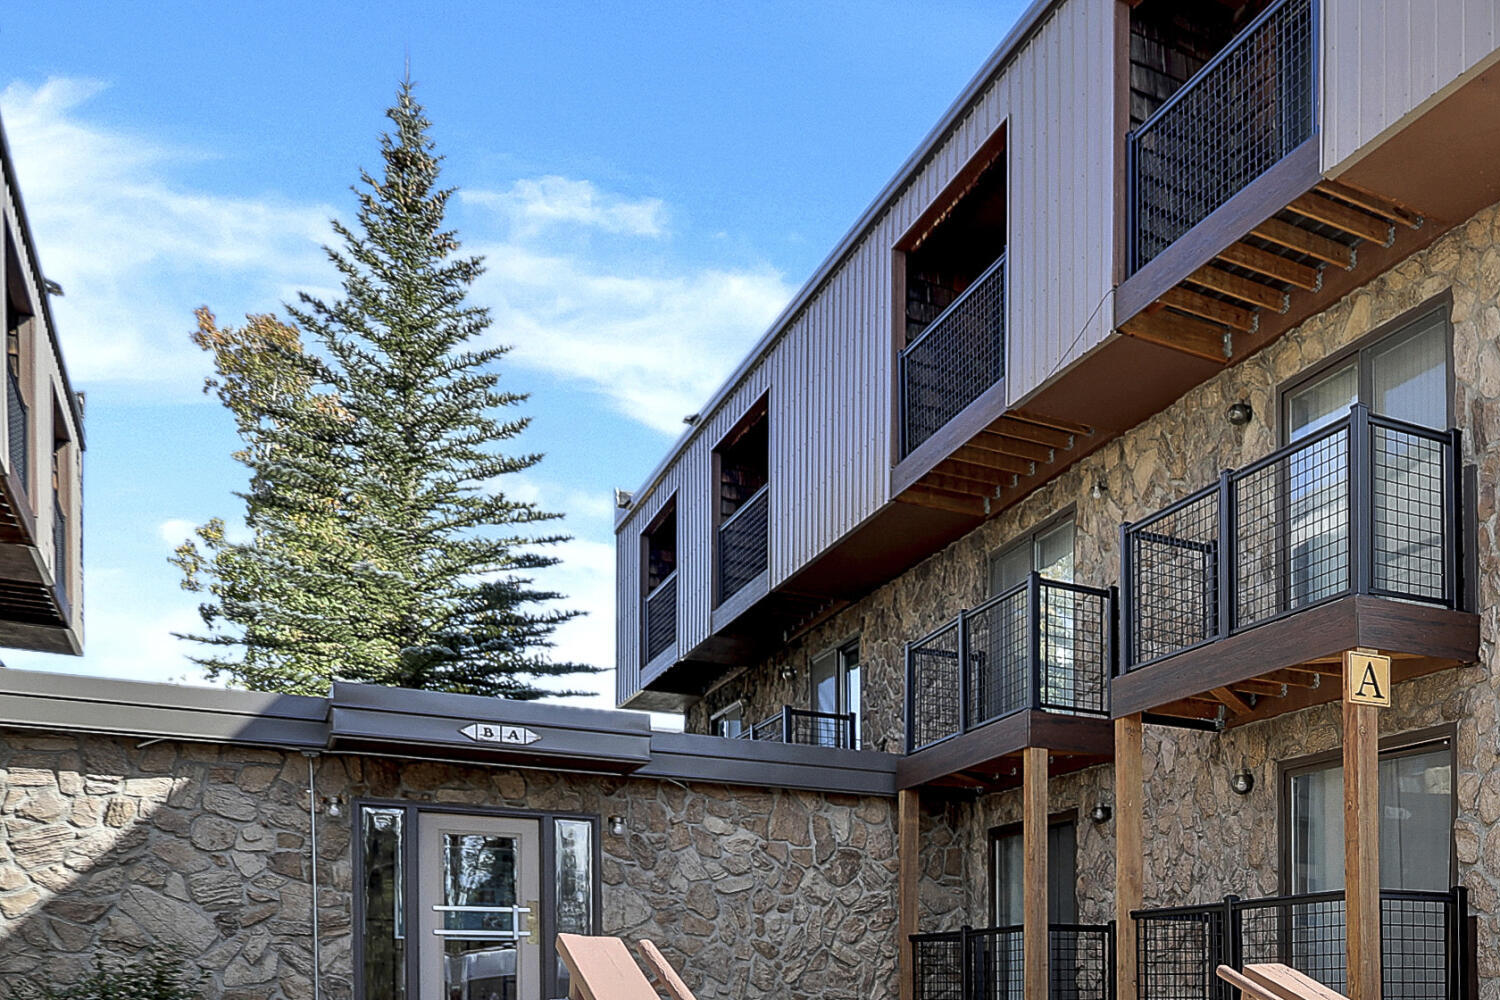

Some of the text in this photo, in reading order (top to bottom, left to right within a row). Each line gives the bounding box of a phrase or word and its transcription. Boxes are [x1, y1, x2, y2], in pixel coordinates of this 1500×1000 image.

[1355, 661, 1385, 699] A
[483, 727, 520, 740] B A
